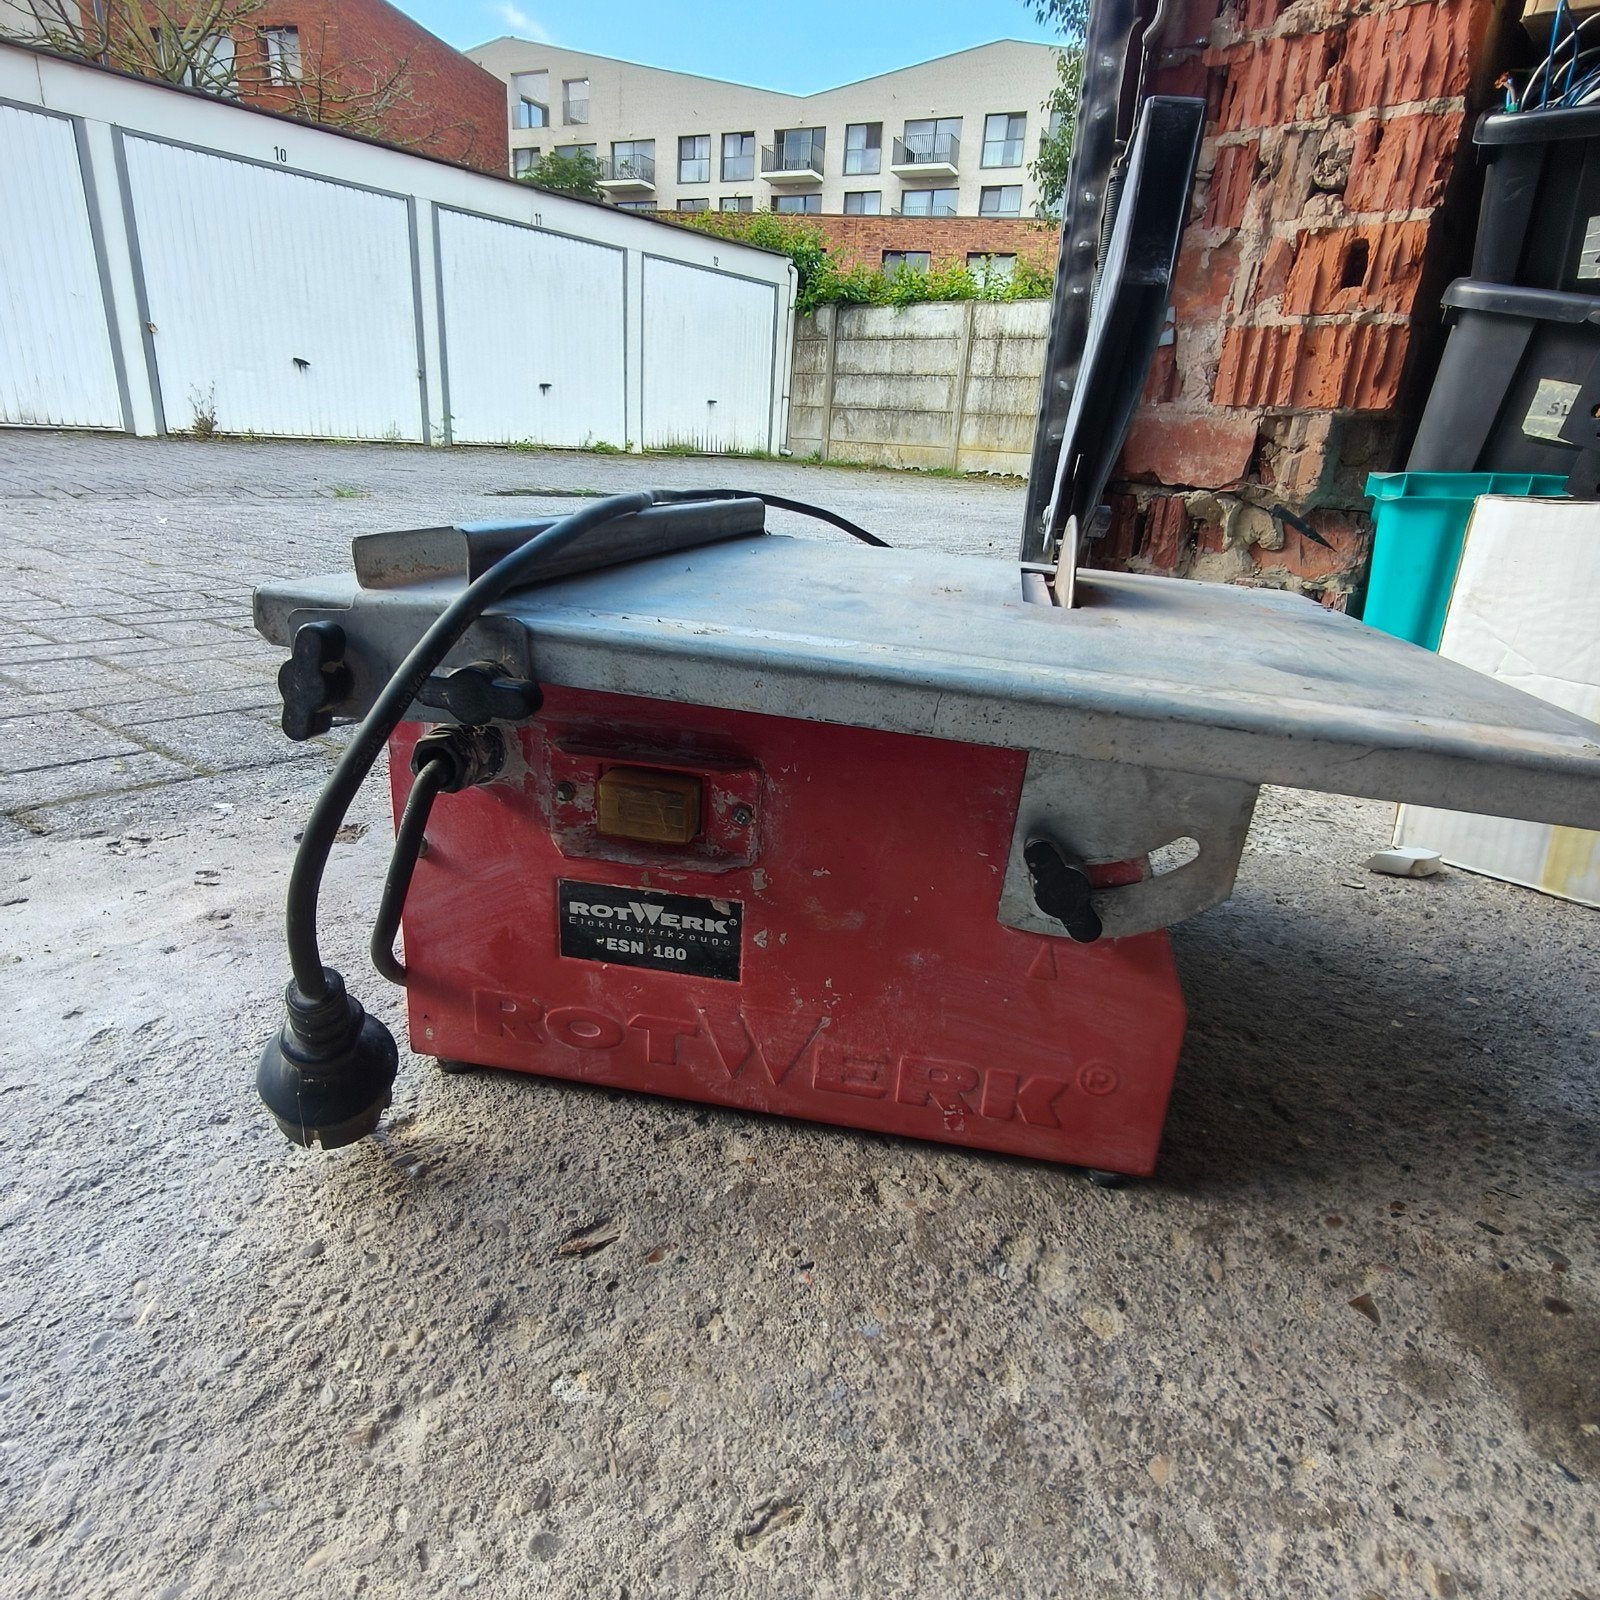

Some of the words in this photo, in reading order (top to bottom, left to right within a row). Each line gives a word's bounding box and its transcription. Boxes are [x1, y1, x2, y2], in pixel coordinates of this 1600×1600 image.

[273, 145, 287, 163] 10
[534, 212, 542, 226] 11
[568, 916, 732, 947] Elektrowerkzeuge
[606, 937, 645, 956] ESN
[653, 944, 688, 962] 180
